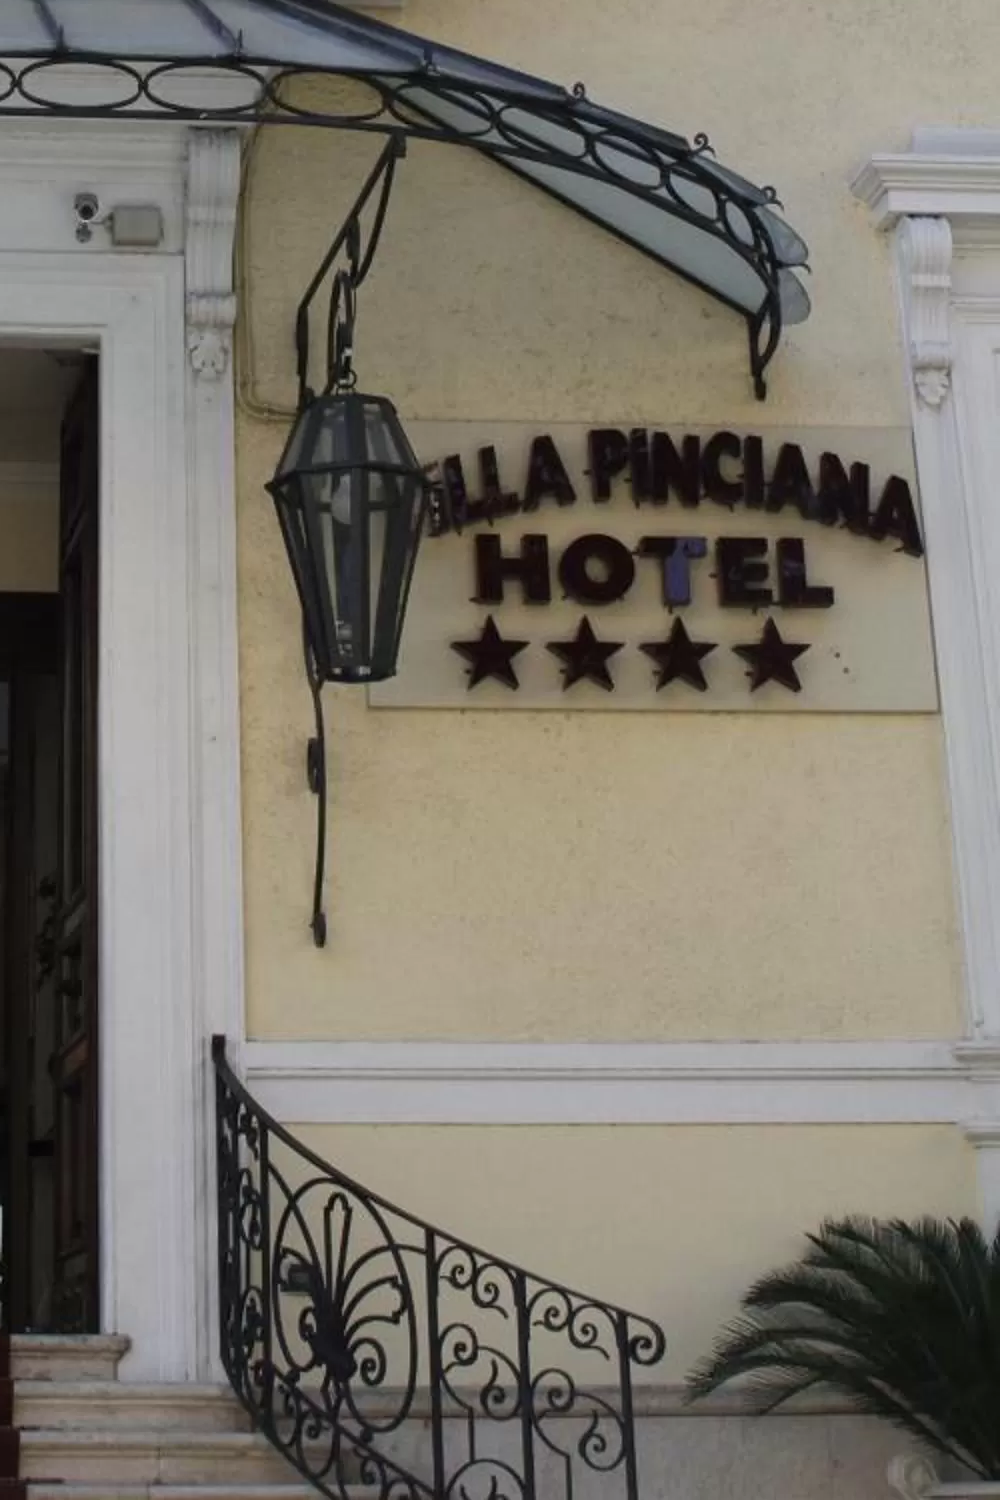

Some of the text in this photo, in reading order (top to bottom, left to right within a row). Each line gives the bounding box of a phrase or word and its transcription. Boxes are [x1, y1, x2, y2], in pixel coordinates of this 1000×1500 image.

[422, 428, 924, 558] ILLA PINCIANA
[473, 534, 834, 608] HOTEL
